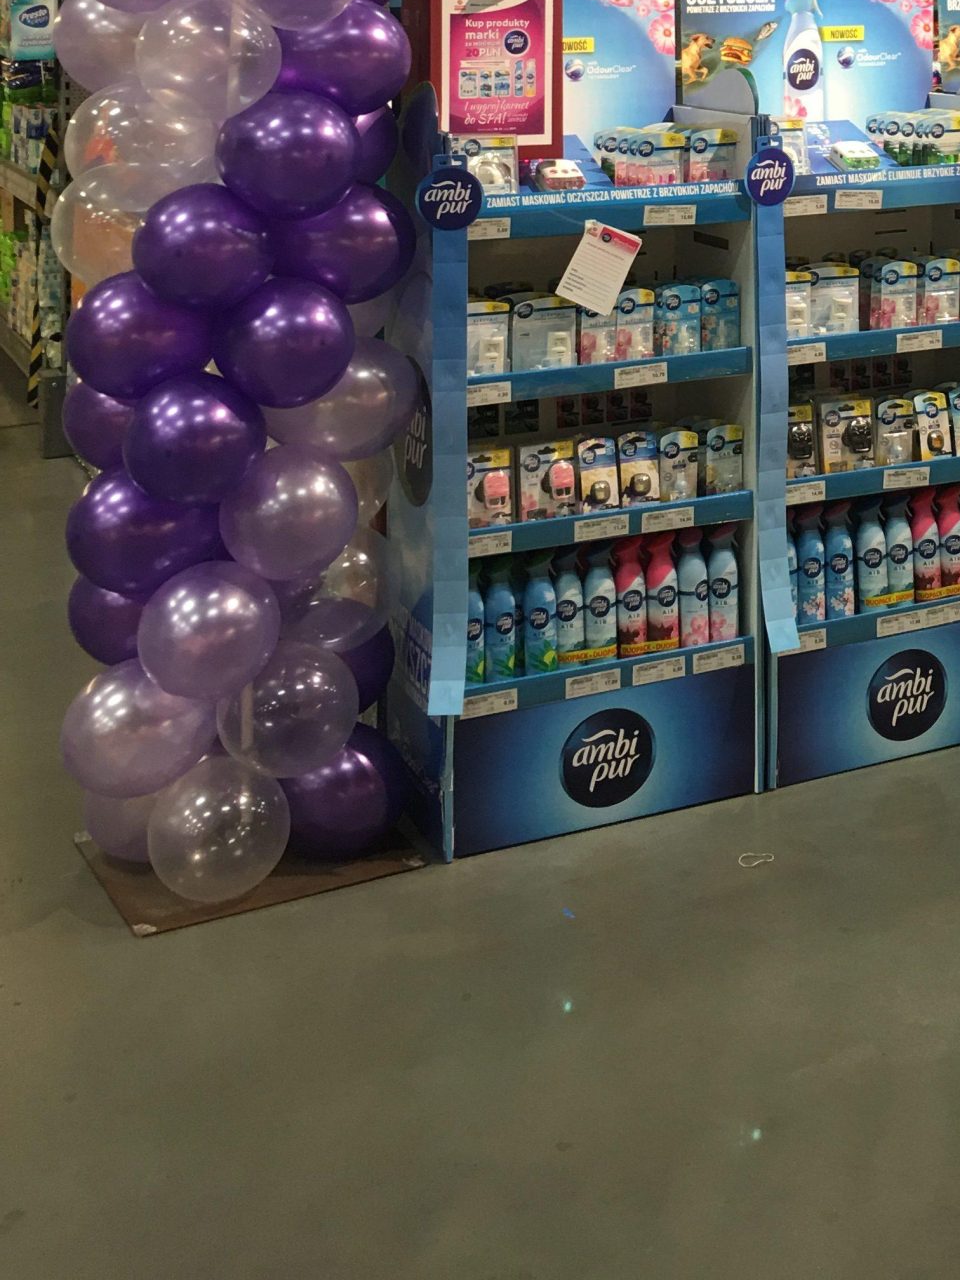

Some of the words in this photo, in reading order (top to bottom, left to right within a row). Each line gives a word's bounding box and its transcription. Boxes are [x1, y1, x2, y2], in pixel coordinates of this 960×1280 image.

[465, 19, 484, 28] Kup
[486, 19, 530, 28] produkty
[465, 29, 499, 40] marki
[789, 58, 815, 73] ambi
[797, 70, 815, 84] pur
[751, 160, 787, 183] ambi
[816, 175, 846, 186] ZAMIAST
[888, 169, 921, 181] ELIMINUJE
[424, 181, 472, 203] ambi
[487, 196, 520, 208] ZAMIAST
[522, 192, 566, 206] MASKOWAĆ
[567, 190, 609, 203] OCZYSZCZA
[611, 187, 651, 200] POWIETRZE
[659, 185, 699, 198] BRZYDKICH
[701, 181, 738, 194] ZAPACHÓW
[760, 178, 787, 197] pur
[437, 198, 472, 220] pur
[876, 668, 934, 704] ambi
[892, 691, 934, 726] pur
[572, 729, 640, 768] ambi
[589, 754, 641, 793] pur
